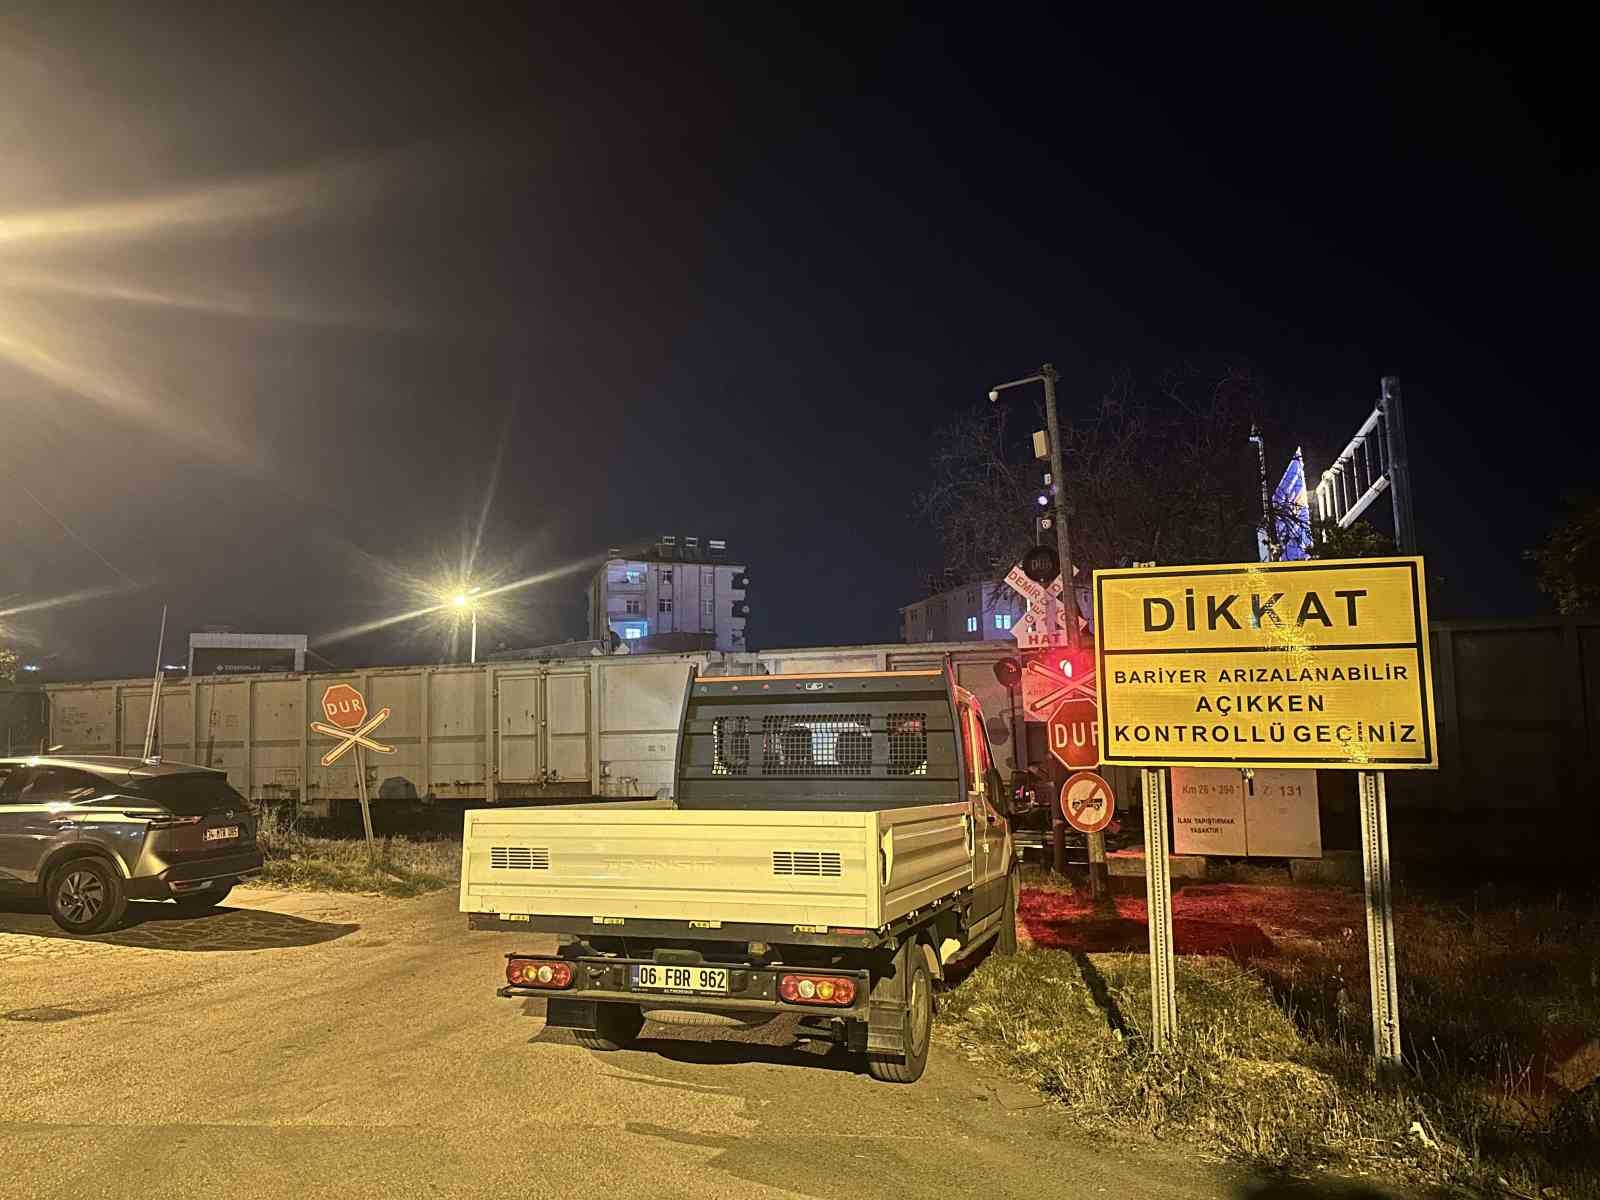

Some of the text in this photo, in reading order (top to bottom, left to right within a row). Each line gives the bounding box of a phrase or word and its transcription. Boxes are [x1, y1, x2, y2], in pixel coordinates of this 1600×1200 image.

[1143, 588, 1367, 632] DİKKAT
[1028, 633, 1061, 645] HAT
[1114, 663, 1409, 684] BARİYER ARIZALANABİLİR
[326, 699, 362, 716] DUR
[1195, 695, 1325, 717] AÇIKKEN
[1115, 720, 1417, 746] KONTROLLÜ GEÇİNİZ
[1280, 785, 1303, 796] 131
[641, 967, 725, 989] 06 FBR 962
